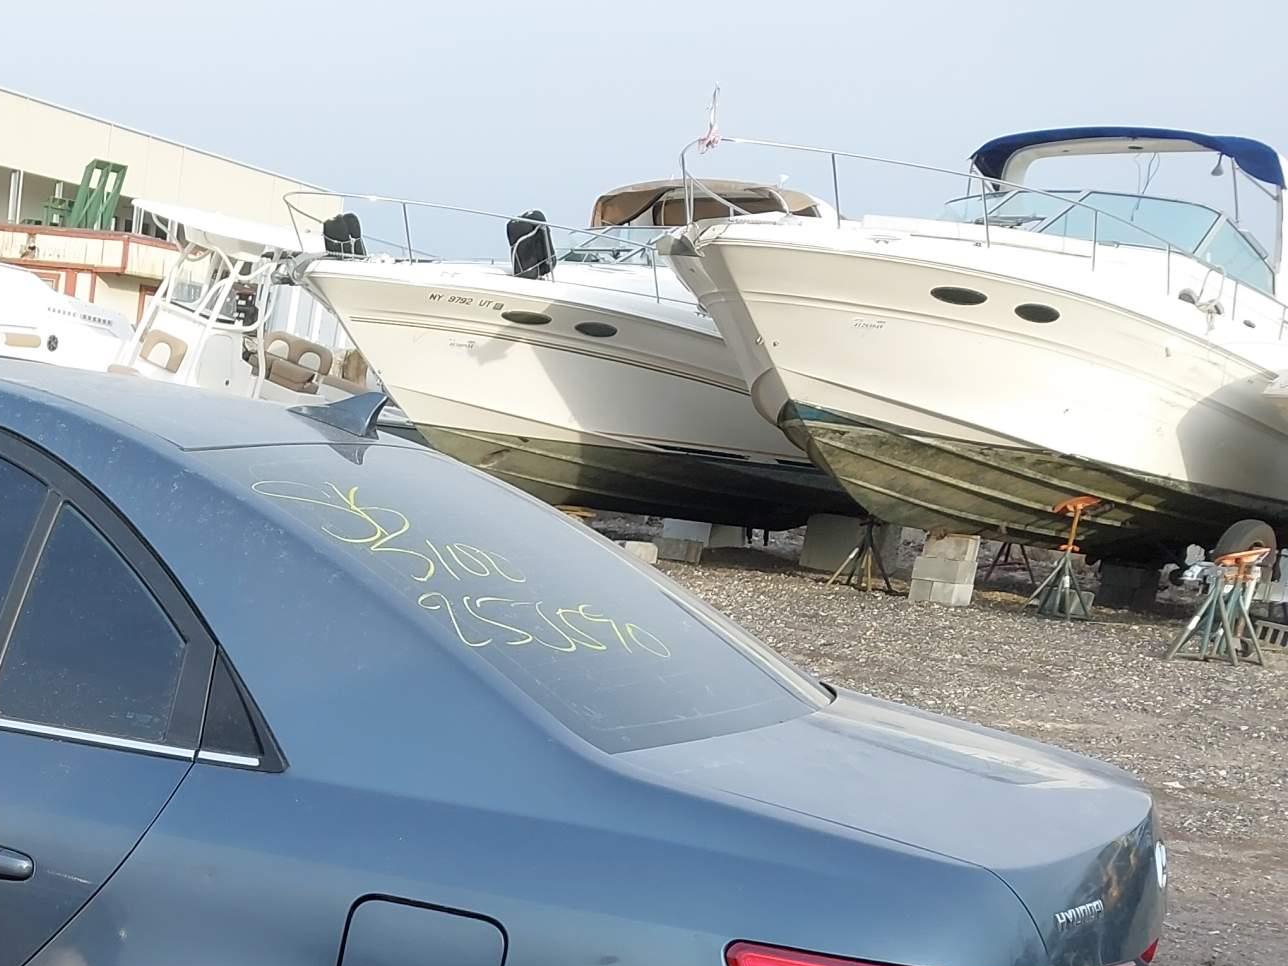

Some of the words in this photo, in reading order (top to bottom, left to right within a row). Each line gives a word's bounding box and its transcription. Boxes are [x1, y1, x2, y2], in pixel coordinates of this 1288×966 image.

[429, 293, 444, 302] NY
[447, 295, 474, 306] 9792
[478, 299, 493, 308] UT
[1055, 899, 1104, 924] HYUNDAI
